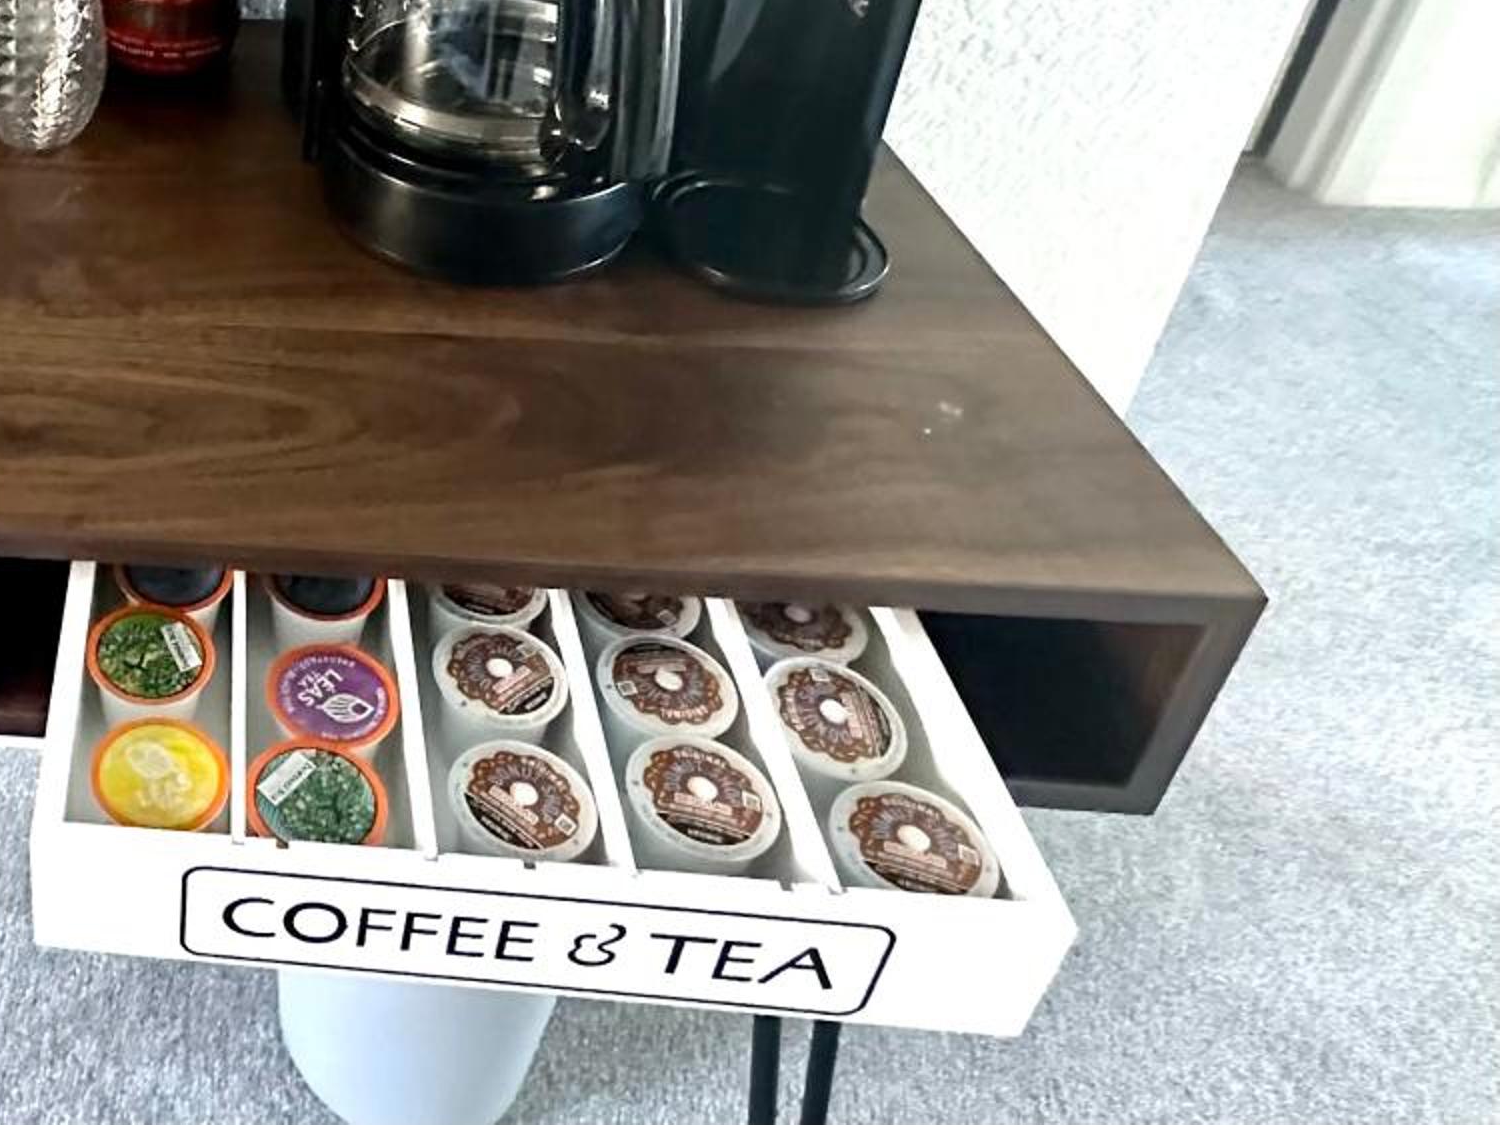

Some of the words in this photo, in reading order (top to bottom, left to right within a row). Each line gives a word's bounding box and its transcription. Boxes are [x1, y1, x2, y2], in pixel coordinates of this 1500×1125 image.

[222, 896, 540, 963] COFFEE
[567, 923, 627, 967] &
[649, 932, 834, 990] TEA
